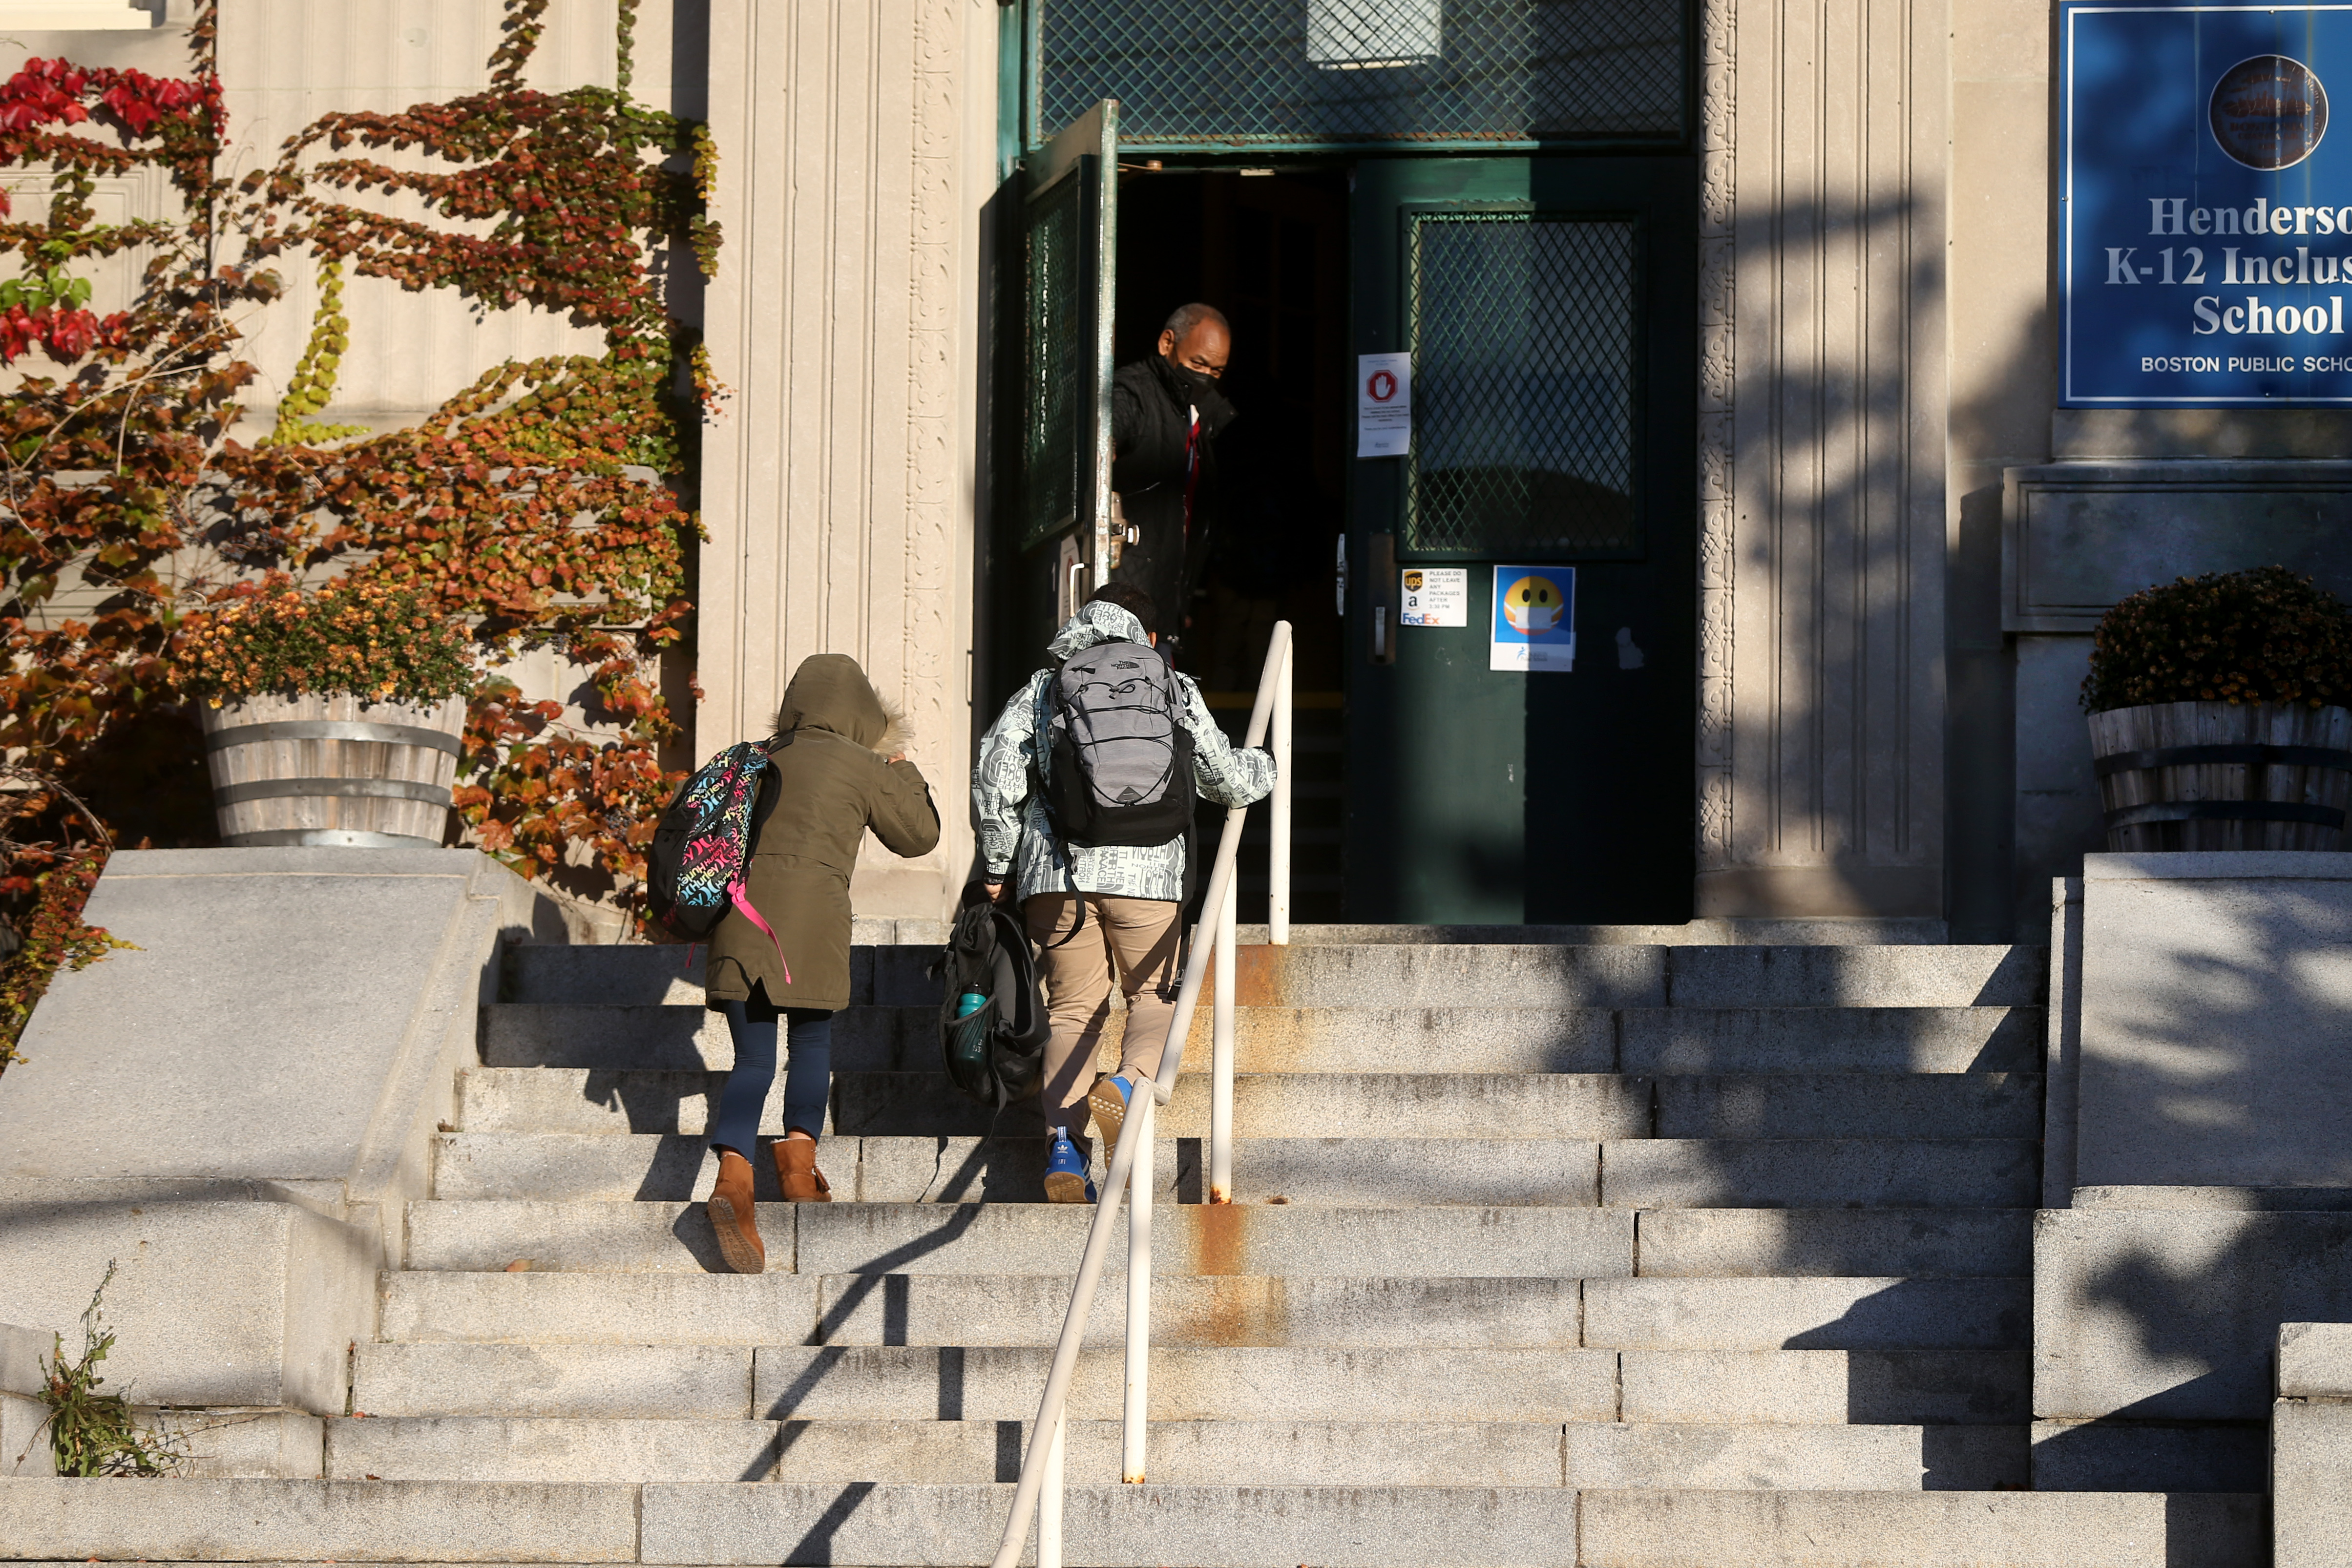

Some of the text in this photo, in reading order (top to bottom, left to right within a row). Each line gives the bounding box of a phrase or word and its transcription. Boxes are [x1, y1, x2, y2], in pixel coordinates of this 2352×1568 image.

[2148, 198, 2352, 235] Henderso
[2104, 247, 2207, 285] K-12
[2193, 296, 2345, 335] School
[2141, 356, 2220, 372] BOSTON
[2227, 356, 2295, 372] PUBLIC
[1405, 577, 1422, 589] ups
[1403, 612, 1440, 624] FedEx
[689, 863, 719, 892] Hurley
